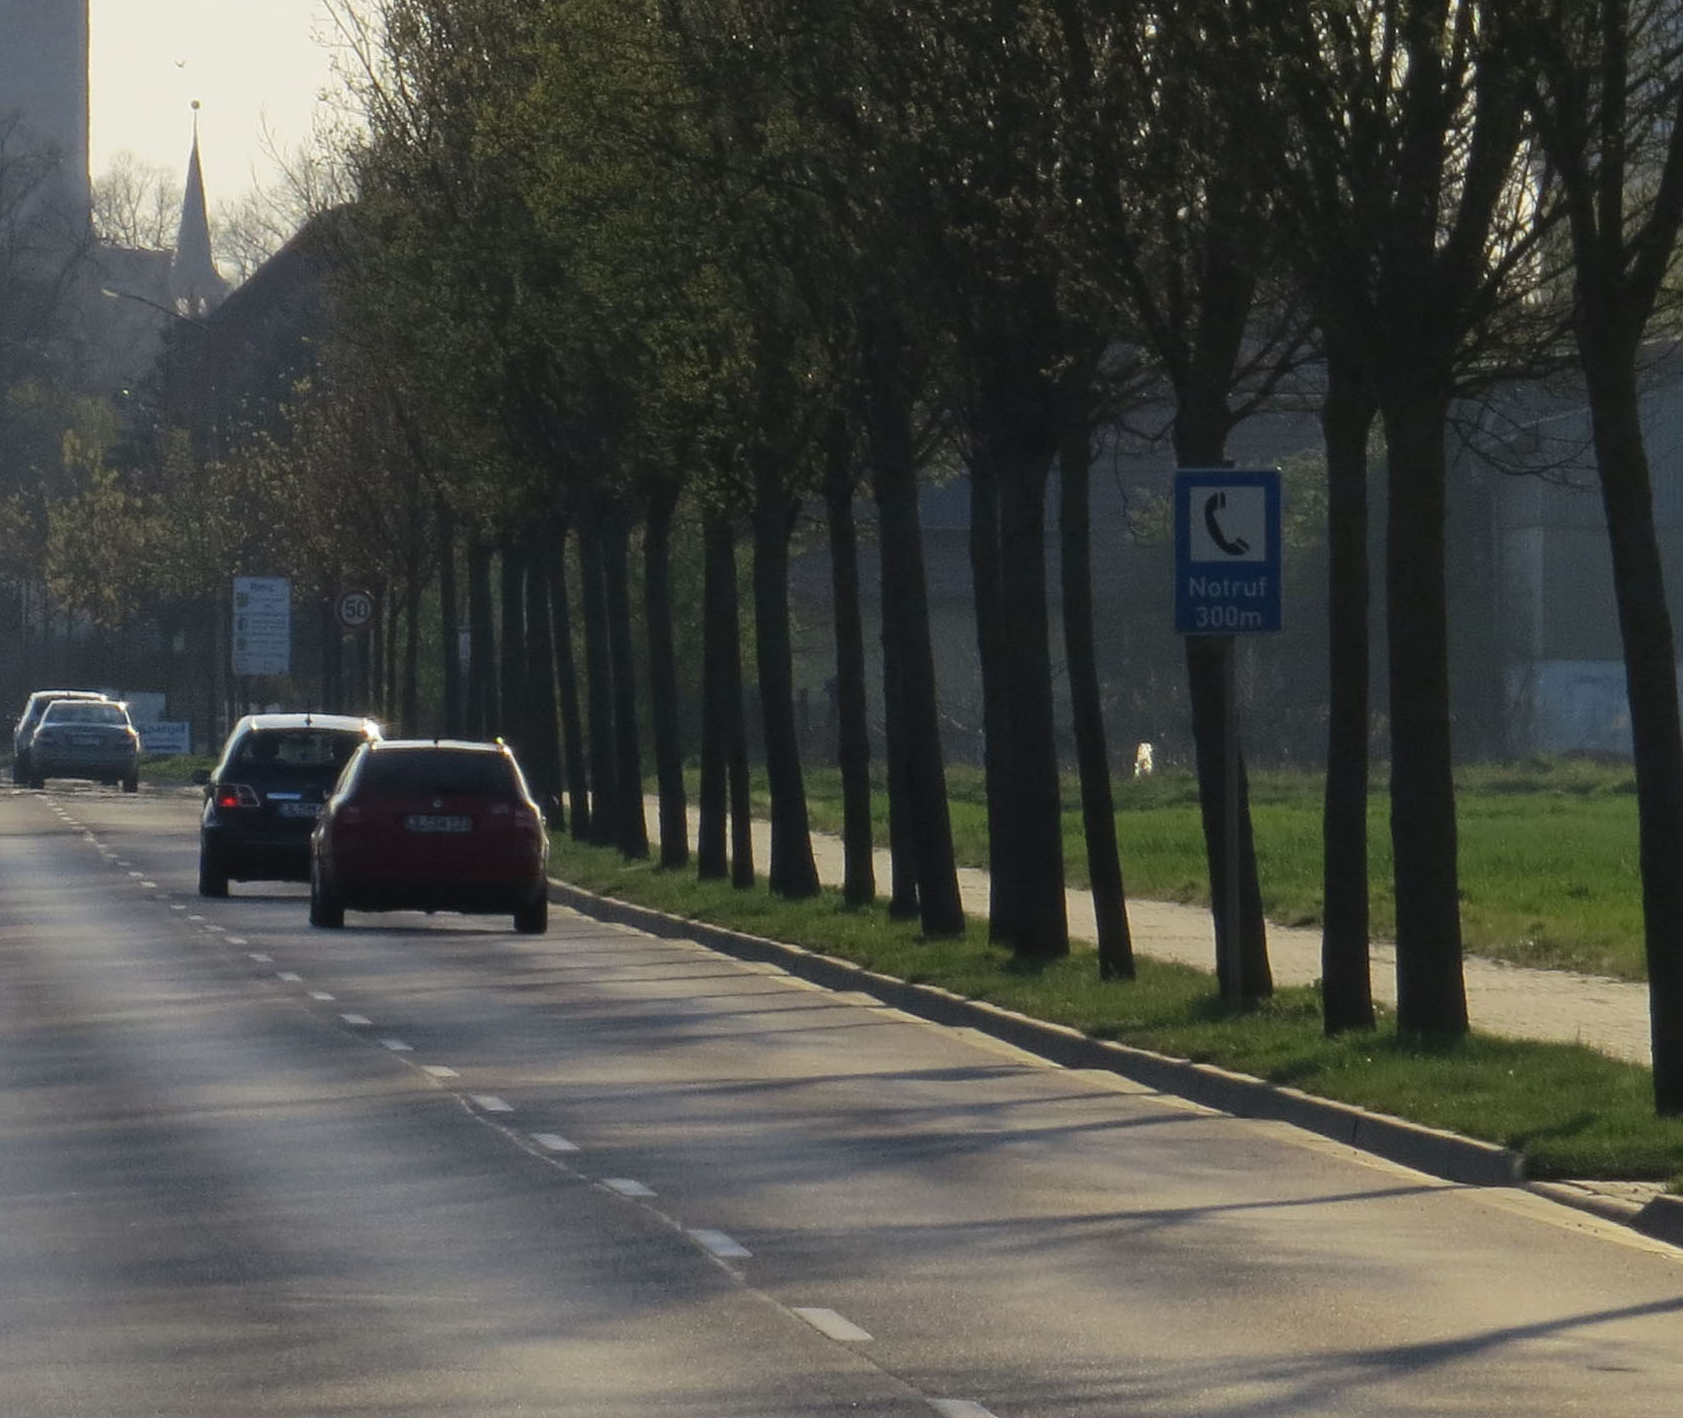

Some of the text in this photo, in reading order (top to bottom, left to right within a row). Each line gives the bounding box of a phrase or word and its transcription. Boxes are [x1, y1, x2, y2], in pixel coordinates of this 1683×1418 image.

[1188, 576, 1269, 597] Notruf
[345, 599, 368, 618] 50
[1195, 605, 1262, 627] 300m
